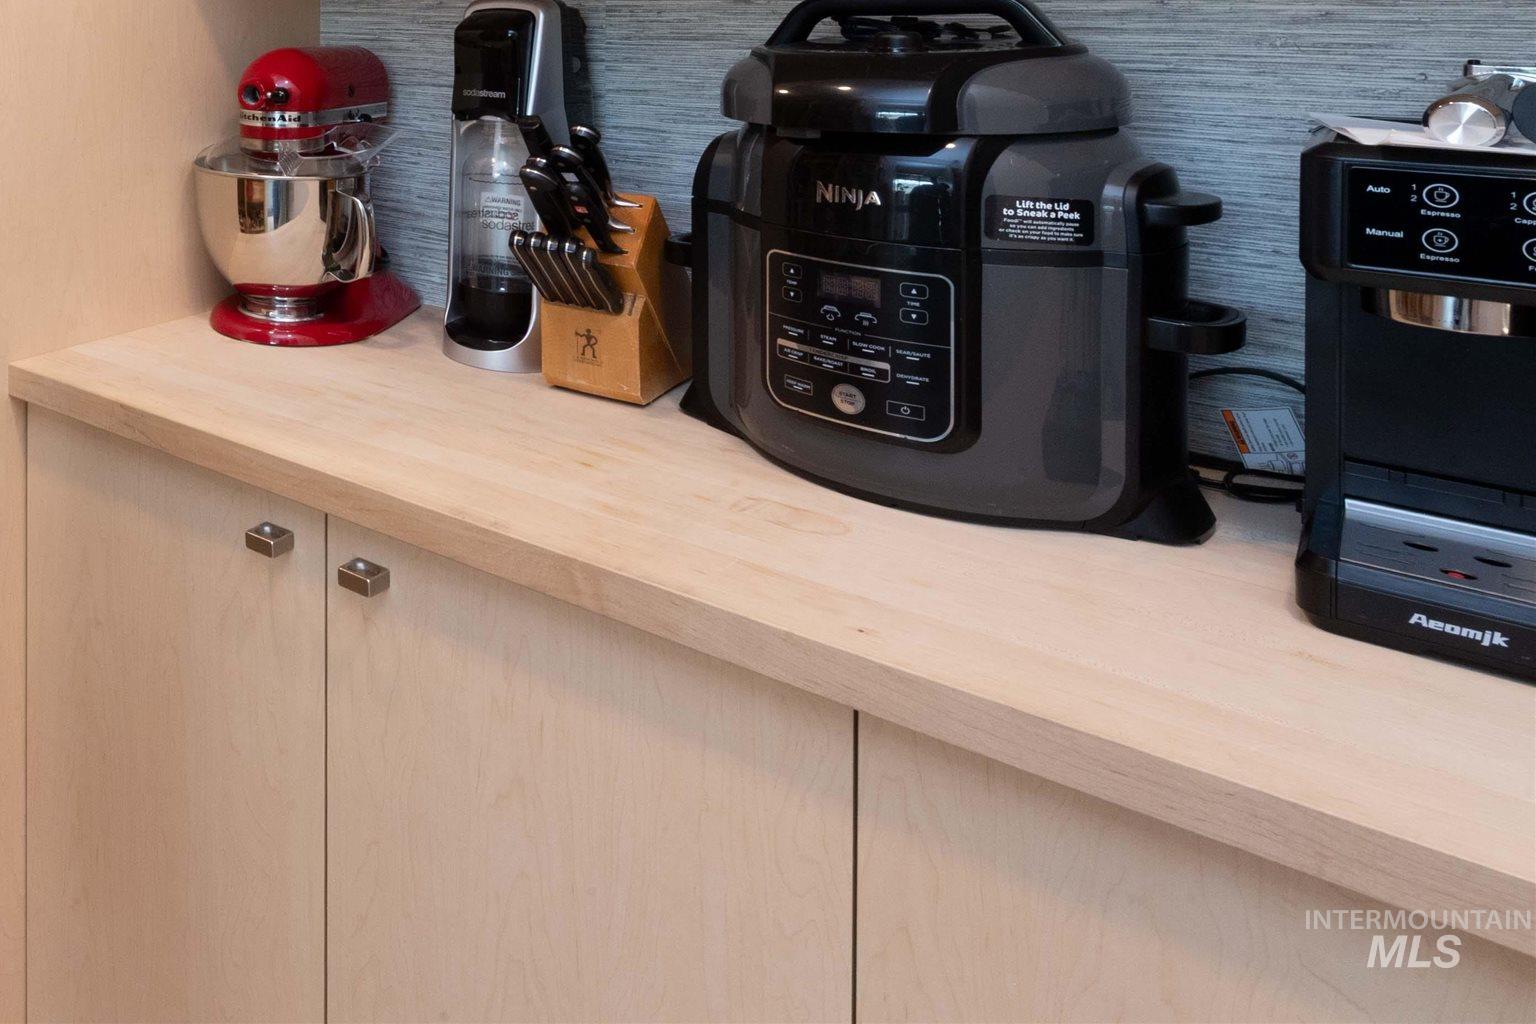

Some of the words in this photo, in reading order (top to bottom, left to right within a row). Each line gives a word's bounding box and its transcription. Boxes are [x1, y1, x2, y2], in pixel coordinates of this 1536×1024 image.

[463, 88, 506, 99] sodastream
[241, 111, 301, 123] itchenAid
[1366, 184, 1391, 194] Auto
[816, 180, 882, 211] NINJA
[1410, 194, 1417, 202] 2
[491, 196, 521, 207] WARNING
[1016, 200, 1035, 209] Lift
[1035, 201, 1053, 210] the
[1054, 202, 1070, 211] Lid
[1003, 207, 1015, 216] to
[1016, 208, 1048, 218] Sneak
[1057, 211, 1081, 220] Peek
[1420, 209, 1461, 219] Espresso
[1365, 227, 1404, 238] Manual
[1419, 253, 1460, 263] Espresso
[896, 373, 930, 383] DEHYDRATE
[838, 390, 857, 399] START
[840, 397, 856, 406] STOP
[1408, 613, 1511, 648] Aeomjk
